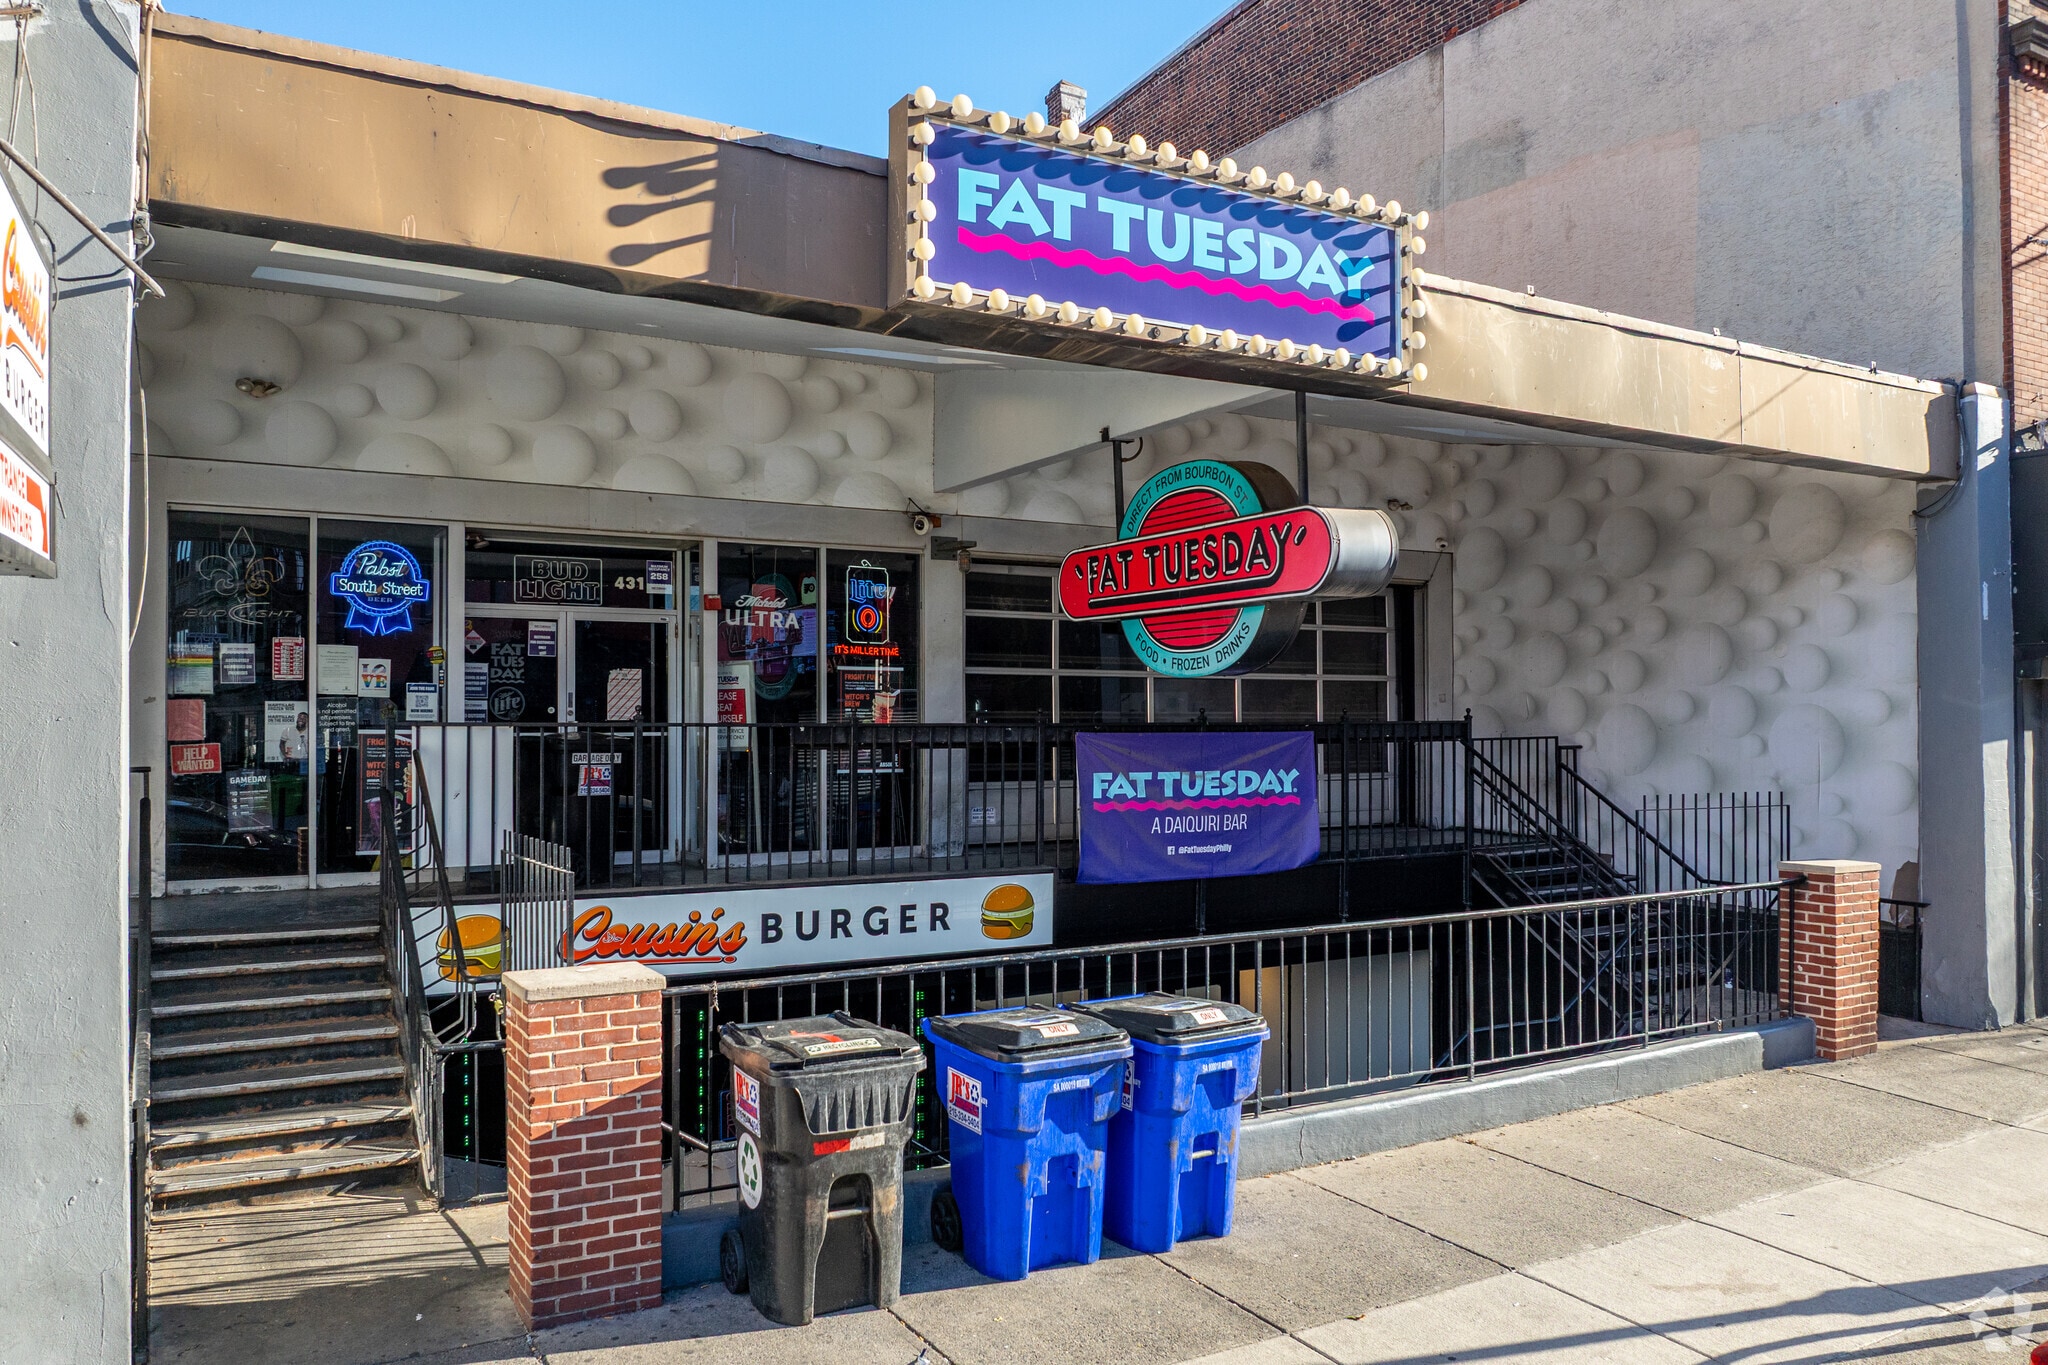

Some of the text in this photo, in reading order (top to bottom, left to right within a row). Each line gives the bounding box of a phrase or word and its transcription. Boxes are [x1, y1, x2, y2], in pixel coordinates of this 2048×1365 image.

[958, 167, 1376, 300] FAT TUESDAY
[6, 357, 45, 441] BURGER
[1127, 465, 1249, 533] DIRECT FROM BOURBON ST.
[356, 552, 408, 578] Pabst
[531, 559, 589, 581] BUD
[614, 576, 645, 590] 431
[650, 572, 669, 581] 258
[339, 578, 424, 597] South Street
[519, 578, 600, 601] LIGHT
[849, 578, 887, 604] Lite
[735, 594, 788, 609] Michelob
[182, 608, 295, 618] BUD LIGHT
[725, 608, 800, 630] ULTRA
[490, 642, 526, 656] FAT
[834, 644, 849, 654] IT'S
[879, 648, 900, 656] TIME
[1135, 621, 1251, 671] FOOD FROZEN DRINKS
[490, 656, 525, 668] TUES
[489, 667, 525, 679] DAY
[844, 673, 866, 681] FRIGHT
[844, 693, 870, 701] WITCH'S
[332, 708, 357, 716] permitted
[494, 696, 521, 715] Lite
[717, 714, 744, 723] URSELF
[183, 746, 209, 761] HELP
[573, 754, 605, 763] GARAGE
[177, 759, 215, 772] WANTED
[366, 760, 401, 769] WITCS
[229, 775, 267, 785] GAMEDAY
[1092, 768, 1300, 800] FAT TUESDAY
[1151, 813, 1248, 834] A DAIQUIRI BAR
[1178, 843, 1233, 854] @FatTuesdayPhilly
[558, 901, 952, 963] Cousin's BURGER
[1199, 1011, 1219, 1021] ONLY
[1047, 1023, 1070, 1034] ONLY
[822, 1040, 864, 1051] RECYCLING
[1053, 1082, 1060, 1092] SA
